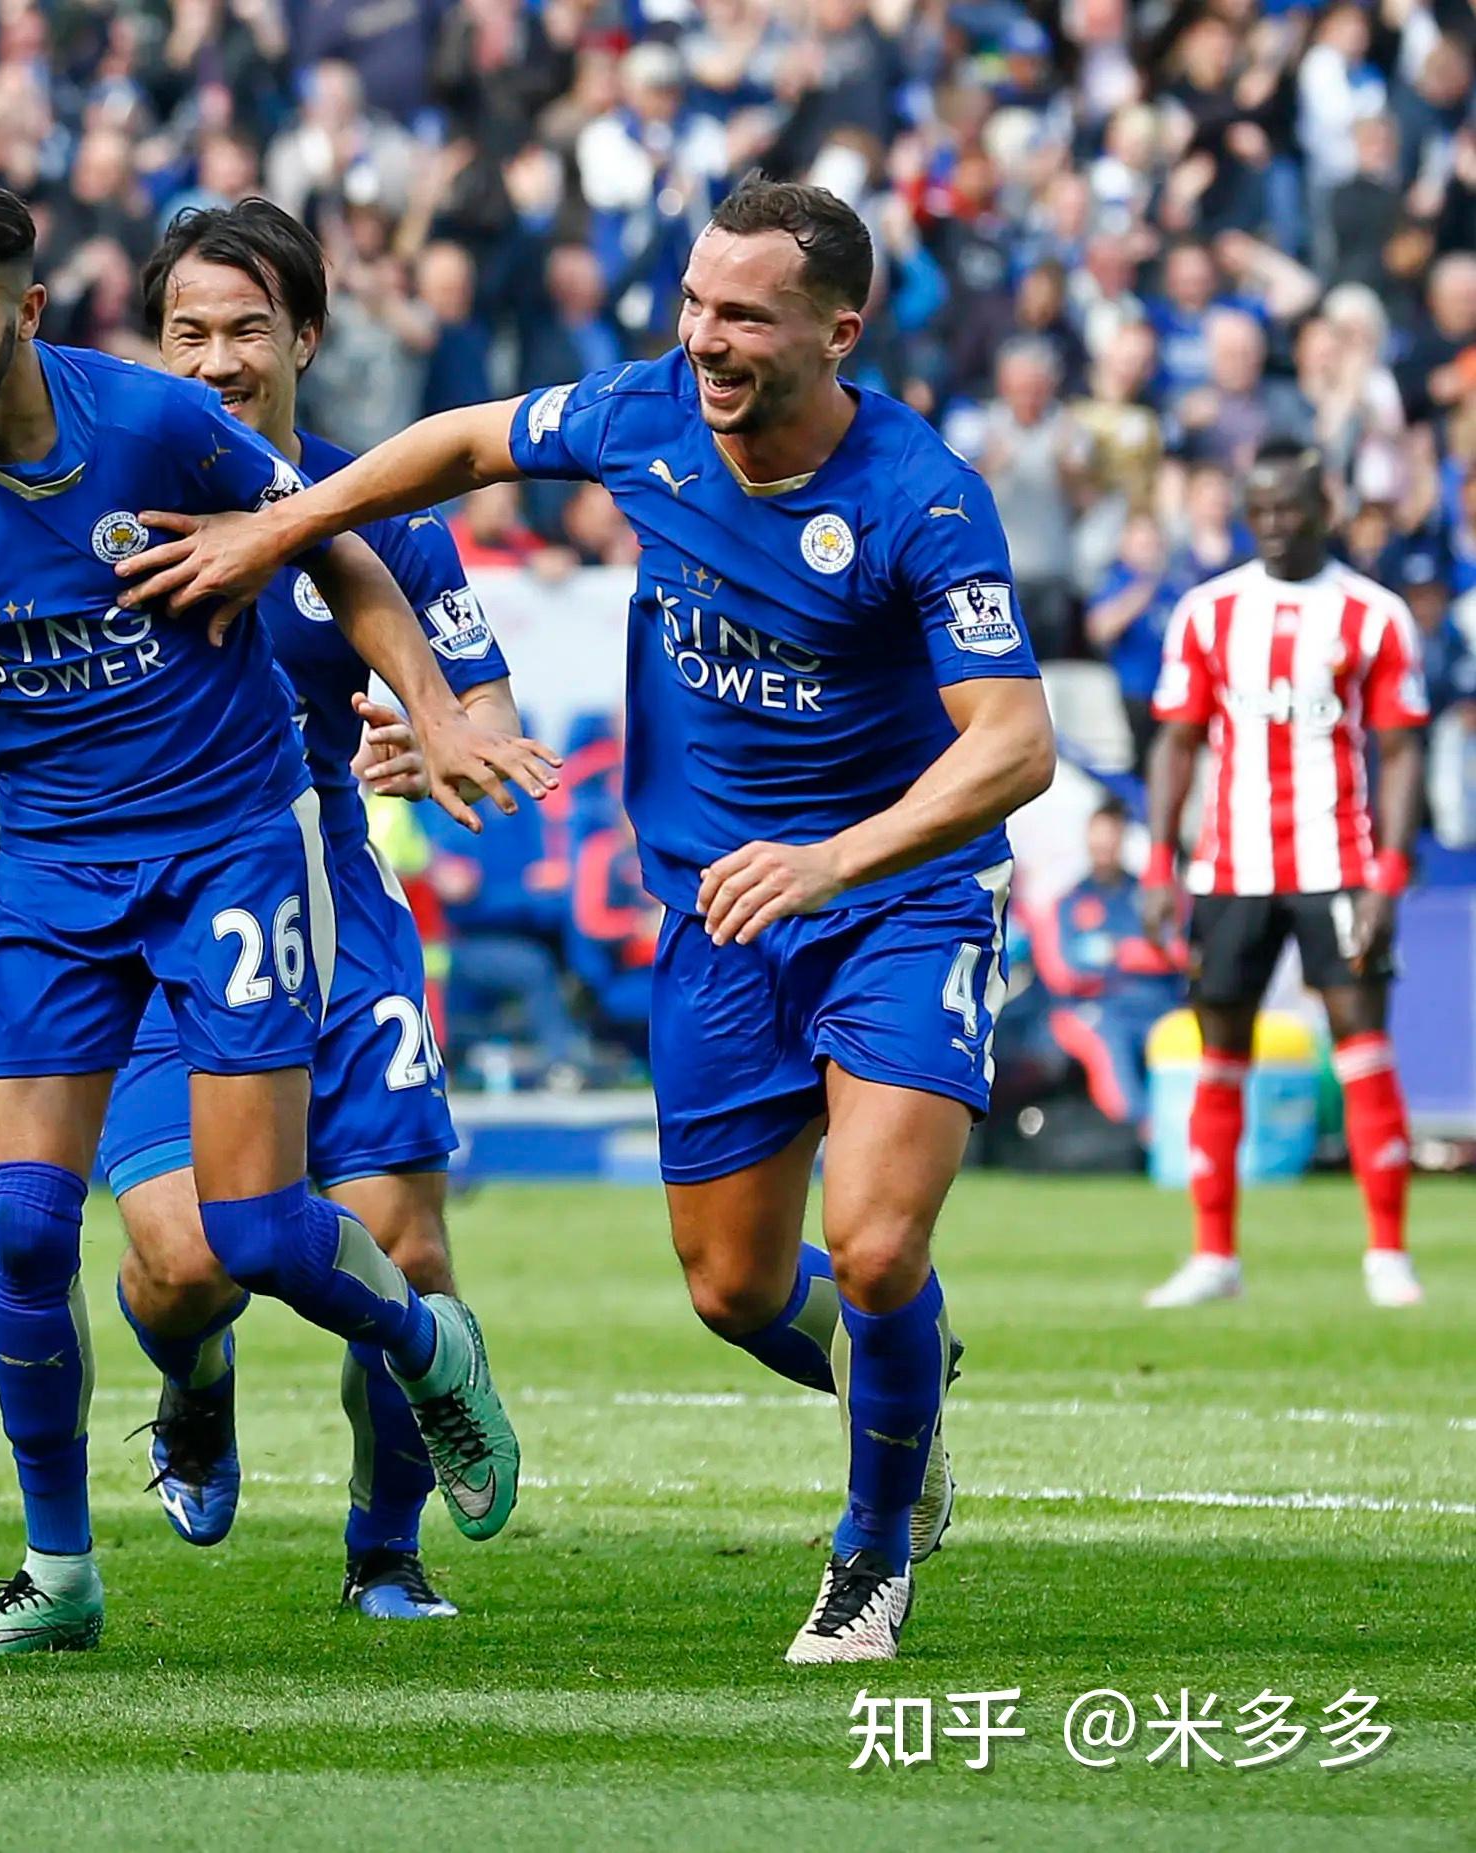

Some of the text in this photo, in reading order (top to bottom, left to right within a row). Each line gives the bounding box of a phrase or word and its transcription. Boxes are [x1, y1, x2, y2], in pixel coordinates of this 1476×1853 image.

[663, 632, 823, 711] POWER
[212, 896, 306, 1008] 26
[942, 943, 982, 1039] 4
